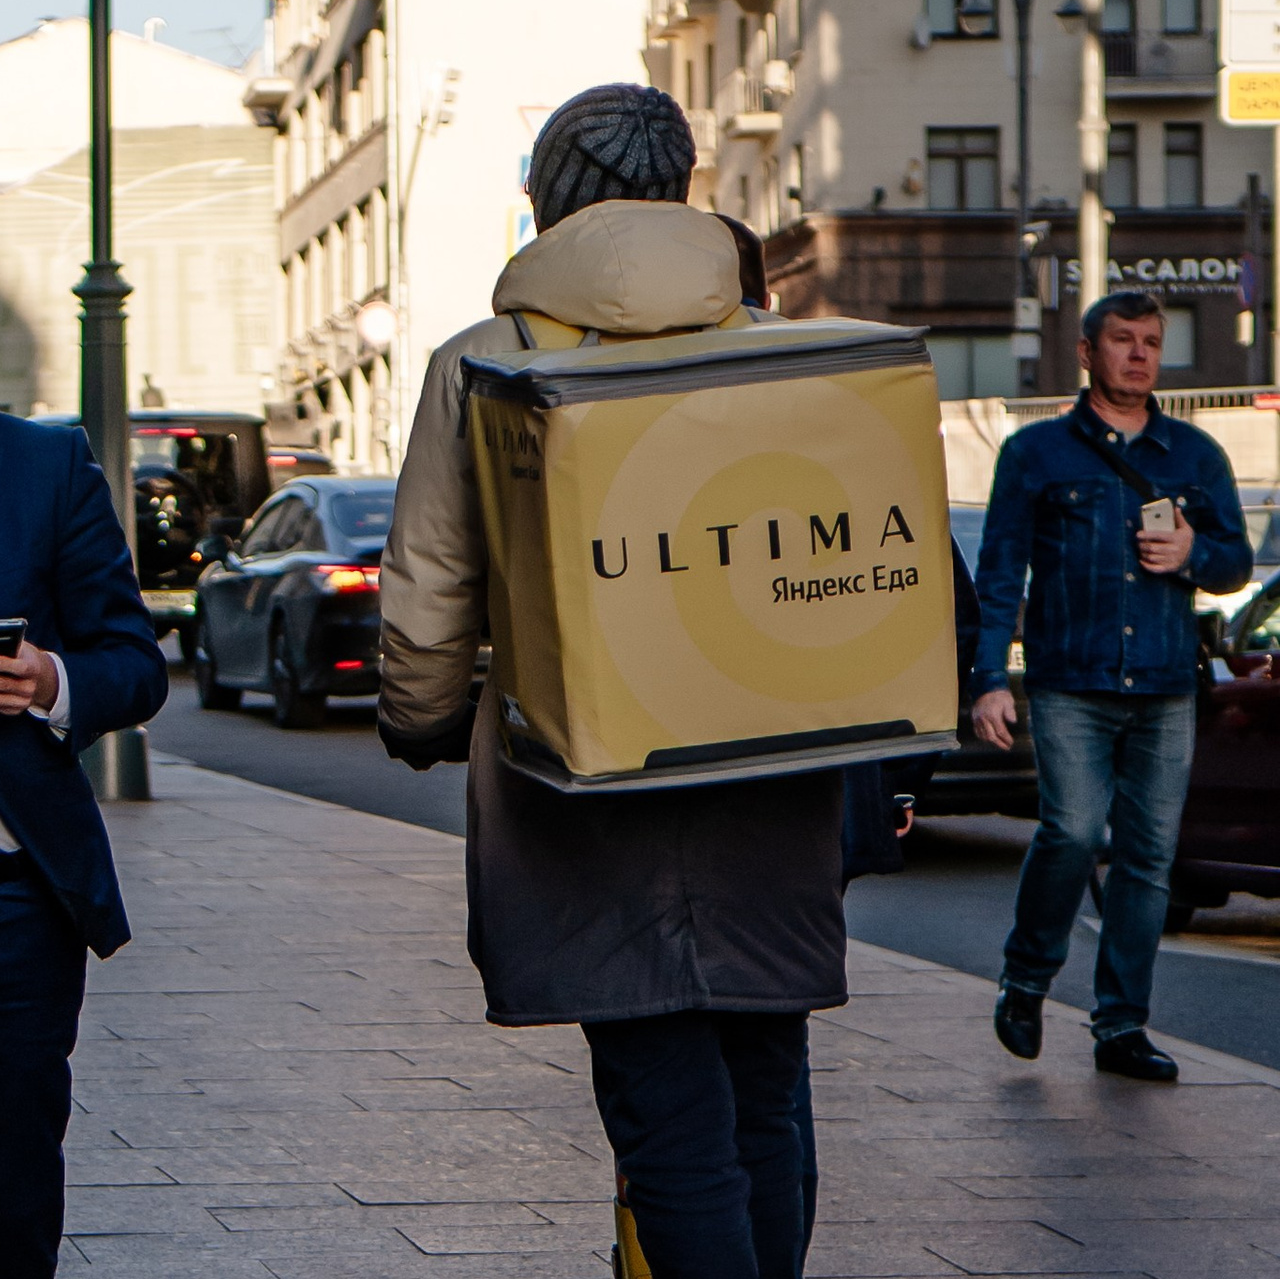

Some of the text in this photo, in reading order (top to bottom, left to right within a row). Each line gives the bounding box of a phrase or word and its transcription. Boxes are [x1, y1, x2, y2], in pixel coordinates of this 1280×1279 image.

[1065, 258, 1243, 281] SA-САЛОН
[592, 505, 916, 580] ULTIMA
[772, 565, 919, 603] Яндекс Еда
